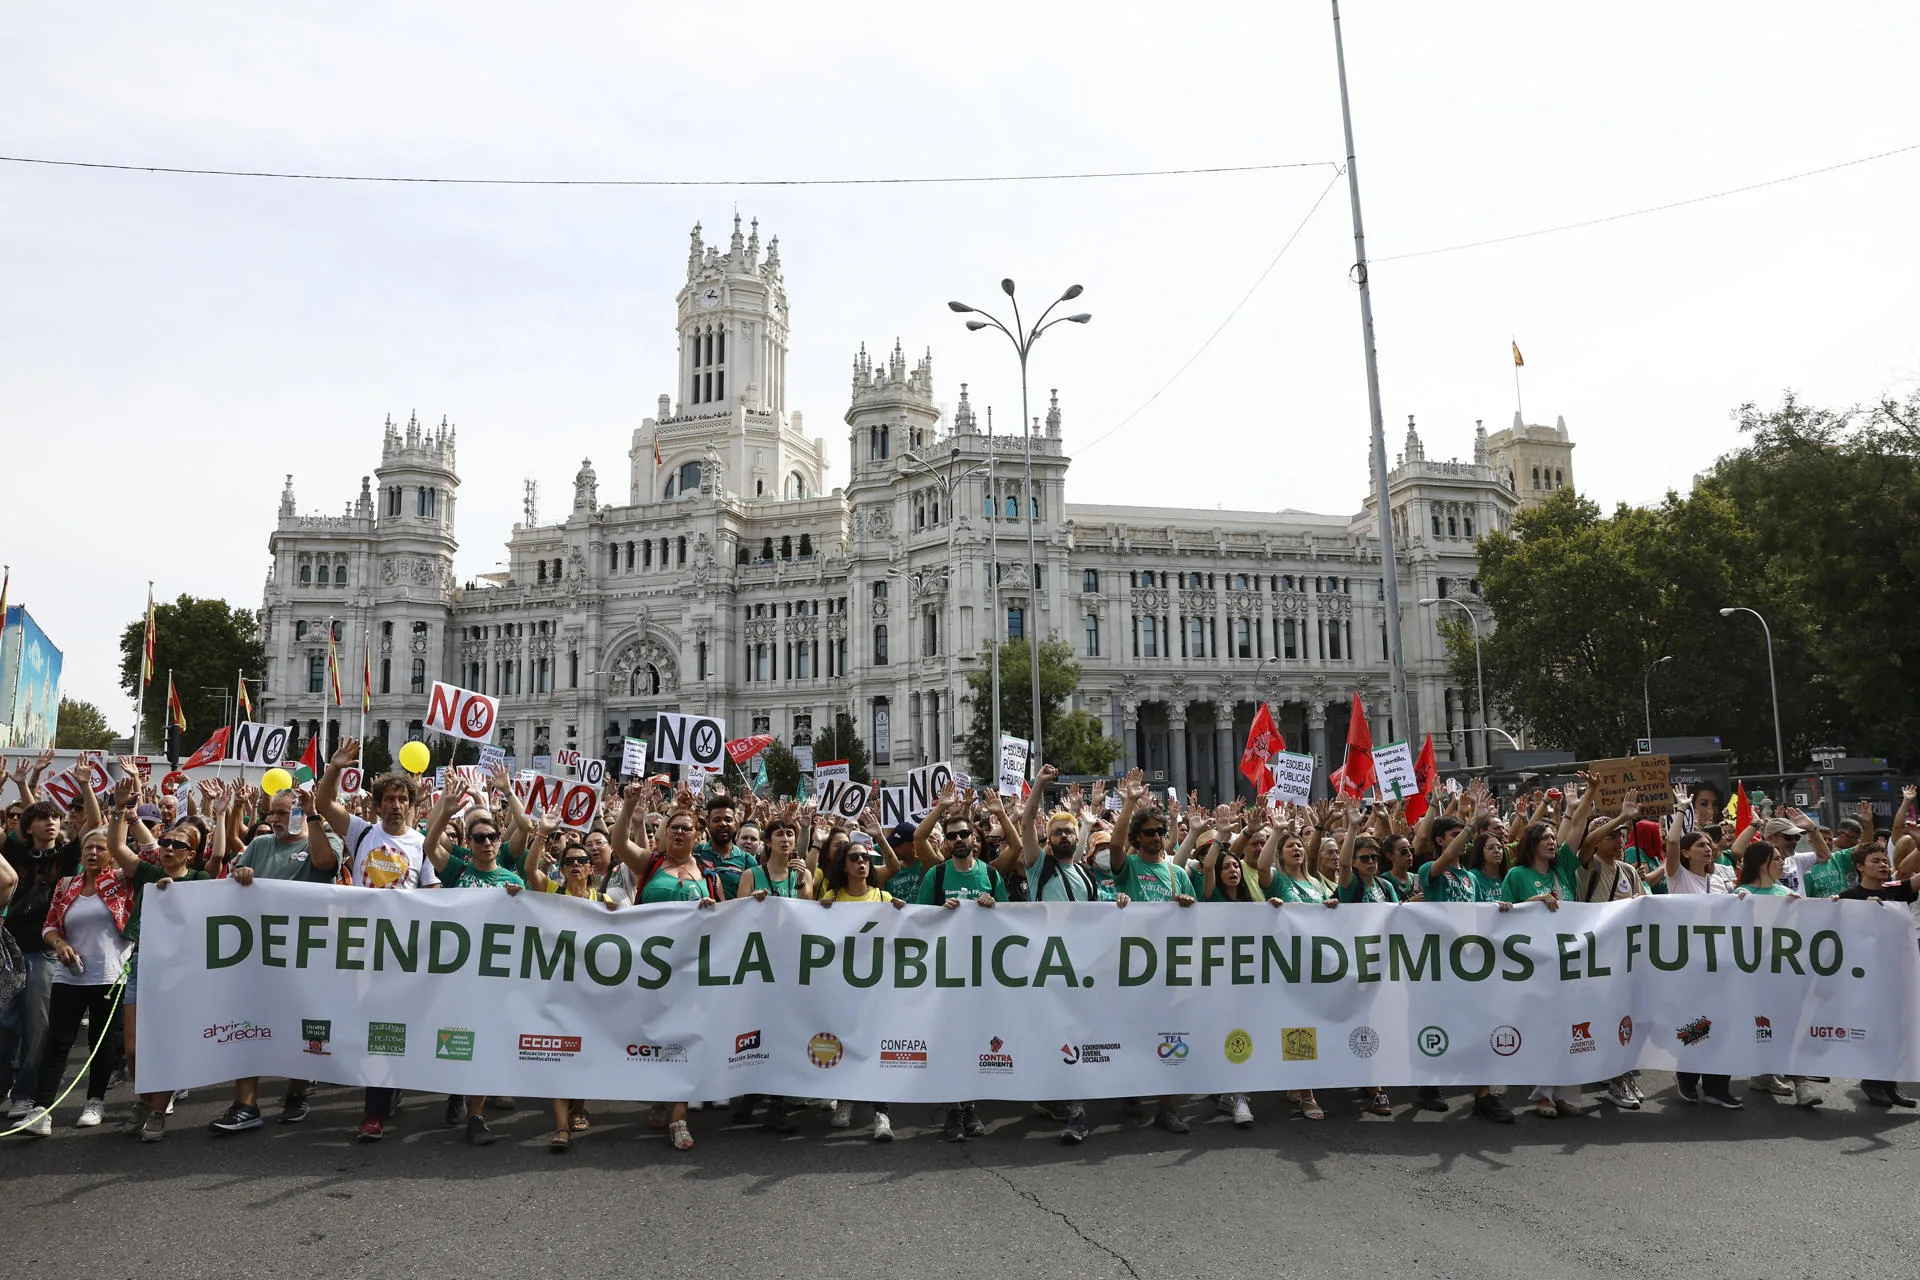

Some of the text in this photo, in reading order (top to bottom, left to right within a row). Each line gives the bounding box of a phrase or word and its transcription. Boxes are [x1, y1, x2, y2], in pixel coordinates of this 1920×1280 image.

[427, 685, 494, 738] NO
[237, 724, 287, 764] NO
[657, 714, 722, 763] NO
[578, 760, 602, 784] NO
[817, 767, 848, 777] La educación,
[1286, 759, 1311, 772] ESCUELAS
[1281, 769, 1311, 784] PÚBLICAS
[910, 765, 951, 812] NO
[525, 775, 596, 826] NO
[819, 779, 865, 817] NO
[105, 886, 118, 896] CGT
[206, 915, 1866, 990] DEFENDEMOS LA PÚBLICA. DEFENDEMOS EL FUTURO.
[1756, 1029, 1772, 1039] STEM
[1810, 1026, 1833, 1038] UGT
[522, 1037, 562, 1049] CCOO
[739, 1036, 756, 1048] CNT
[880, 1040, 927, 1051] CONFAPA
[1164, 1035, 1182, 1043] TEA
[1426, 1034, 1441, 1049] FP
[1571, 1040, 1595, 1048] JUVENTUD
[626, 1044, 662, 1057] CGT
[1570, 1046, 1596, 1054] COMUNISTA
[728, 1055, 746, 1063] Sección
